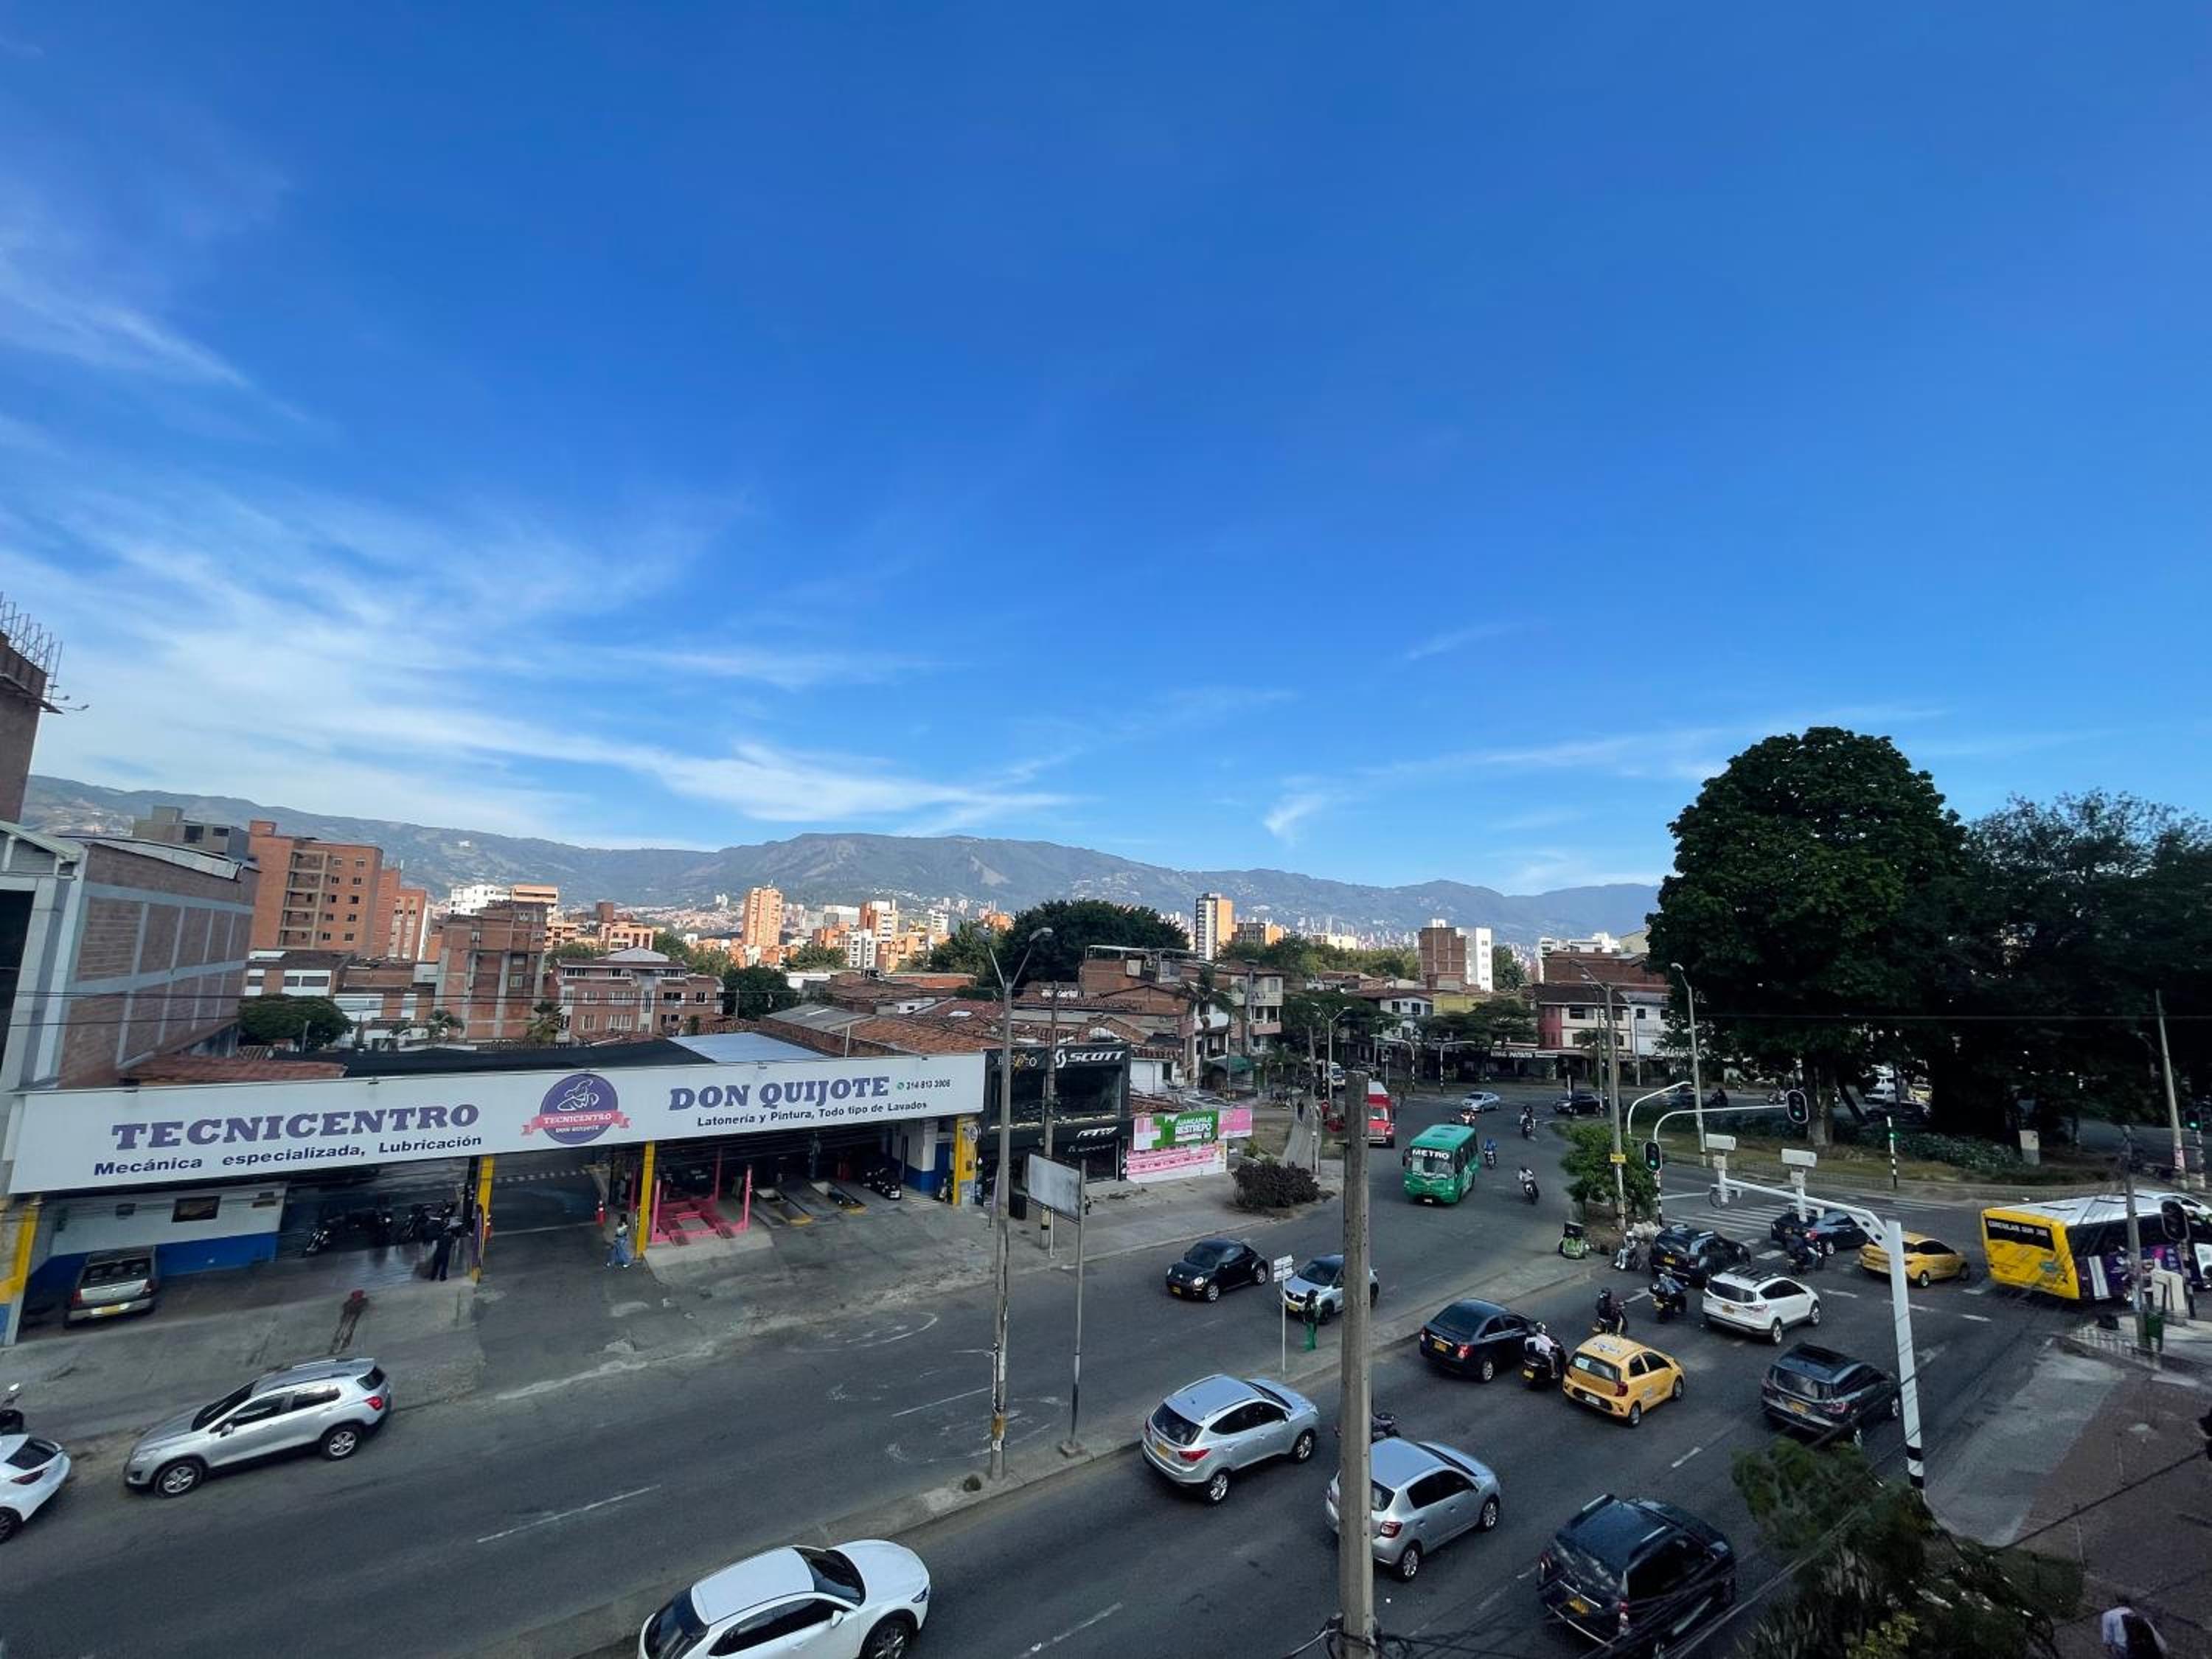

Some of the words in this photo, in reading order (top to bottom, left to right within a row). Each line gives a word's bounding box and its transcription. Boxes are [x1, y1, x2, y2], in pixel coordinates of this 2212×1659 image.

[1068, 1051, 1125, 1062] SCOTT
[668, 1085, 751, 1111] DON
[759, 1076, 890, 1110] QUIJOTE
[759, 1115, 766, 1124] y
[771, 1108, 815, 1121] Pintura,
[819, 1107, 844, 1118] Todo
[848, 1105, 868, 1116] tipo
[871, 1104, 883, 1113] de
[888, 1102, 927, 1112] Lavados
[111, 1104, 479, 1151] TECNICENTRO
[1175, 1123, 1212, 1135] RESTREPO
[94, 1155, 203, 1176] Mecánica
[222, 1144, 365, 1166] especializada,
[379, 1135, 481, 1154] Lubricación
[1412, 1149, 1450, 1160] METRO
